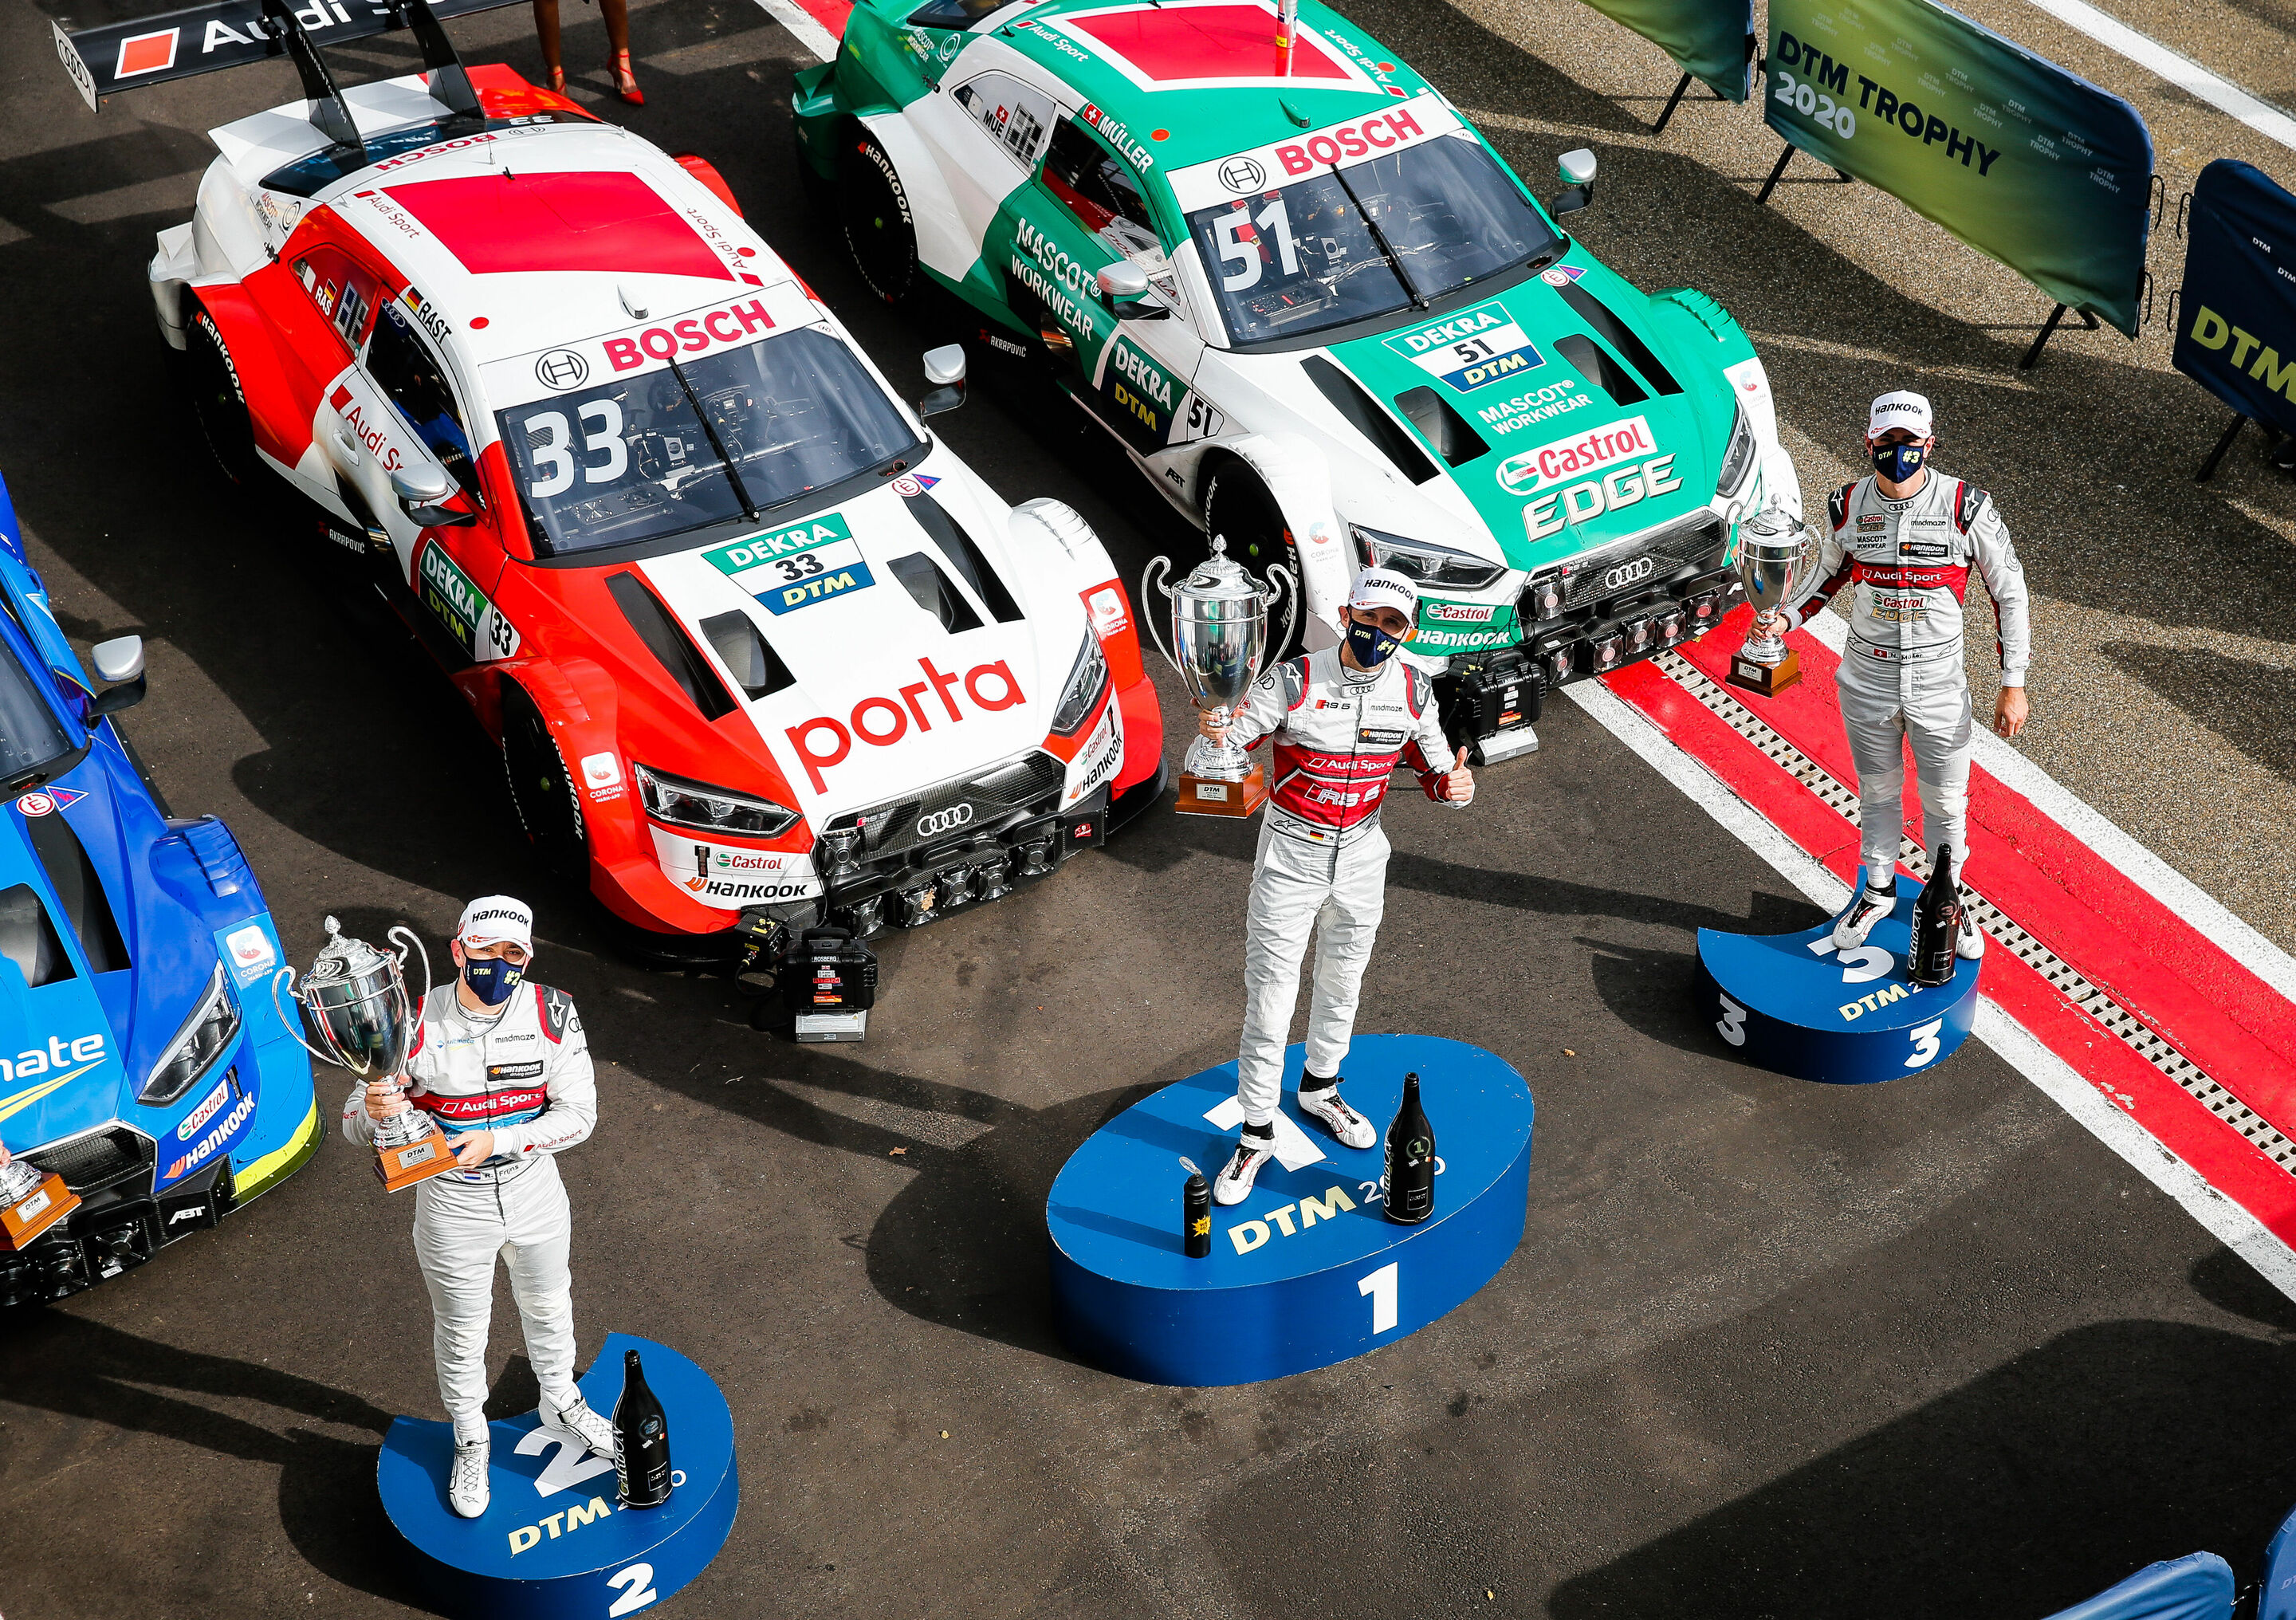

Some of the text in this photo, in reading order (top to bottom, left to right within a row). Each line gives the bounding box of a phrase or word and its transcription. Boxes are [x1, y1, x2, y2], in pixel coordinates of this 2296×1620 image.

[1028, 24, 1089, 63] Audi Sport
[1324, 29, 1392, 84] Audi Sport
[1917, 77, 1947, 97] TROPHY
[1924, 72, 1940, 85] DTM
[1945, 73, 1975, 93] TROPHY
[1952, 67, 1968, 81] DTM
[1774, 71, 1856, 140] 2020
[1777, 30, 2001, 178] DTM TROPHY
[1973, 108, 2003, 128] TROPHY
[1980, 103, 1996, 117] DTM
[2002, 104, 2032, 124] TROPHY
[2008, 99, 2026, 113] DTM
[983, 108, 1004, 139] MUE
[2068, 131, 2086, 144] DTM
[374, 134, 498, 171] BOSCH
[1099, 116, 1154, 174] MÜLLER
[1275, 109, 1424, 176] BOSCH
[2030, 140, 2060, 161] TROPHY
[2037, 134, 2054, 149] DTM
[2062, 135, 2094, 158] TROPHY
[2090, 171, 2121, 194] TROPHY
[2097, 167, 2115, 182] DTM
[367, 196, 421, 238] Audi Sport
[686, 207, 744, 269] Audi Sport
[1212, 199, 1299, 293] 51
[2252, 237, 2270, 253] DTM
[2278, 266, 2296, 283] DTM
[1012, 255, 1093, 340] WORKWEAR
[419, 301, 452, 344] RAST
[603, 299, 776, 372] BOSCH
[1404, 311, 1502, 352] DEKRA
[1453, 339, 1496, 363] 51
[2190, 305, 2296, 404] DTM
[1116, 342, 1171, 410] DEKRA
[1462, 352, 1529, 386] DTM
[1115, 382, 1157, 431] DTM
[1188, 398, 1213, 438] 51
[1491, 394, 1594, 435] WORKWEAR
[346, 406, 388, 457] Audi
[523, 399, 628, 498] 33
[1537, 423, 1649, 480] Castrol
[1878, 450, 1921, 463] DTM #3
[1165, 467, 1185, 488] ABT
[1522, 453, 1684, 543] EDGE
[1857, 523, 1885, 533] EDGE
[1864, 514, 1883, 523] Castrol
[726, 523, 838, 568] DEKRA
[776, 553, 824, 581] 33
[1874, 571, 1941, 583] Audi Sport
[426, 547, 477, 623] DEKRA
[782, 571, 856, 607] DTM
[429, 588, 467, 644] DTM
[1443, 606, 1490, 619] Castrol
[1870, 608, 1928, 623] EDGE
[1883, 597, 1924, 609] Castrol
[490, 611, 513, 656] 33
[1355, 630, 1395, 655] DTM #1
[784, 657, 1027, 796] porta
[1087, 722, 1107, 758] Castrol
[1327, 759, 1358, 770] Audi
[589, 785, 623, 799] CORONA
[732, 855, 782, 871] Castrol
[241, 958, 276, 977] CORONA
[503, 970, 521, 985] #2
[1838, 983, 1909, 1022] DTM
[1716, 993, 1746, 1046] 3
[495, 1034, 536, 1044] mindmaze
[1904, 1018, 1942, 1068] 3
[191, 1083, 227, 1131] Castrol
[461, 1093, 542, 1112] Audi Sport
[407, 1147, 425, 1158] DTM
[536, 1129, 583, 1150] Audi Sport
[1414, 1141, 1425, 1154] 1
[25, 1197, 41, 1210] DTM
[168, 1205, 206, 1225] ABT
[1227, 1186, 1357, 1256] DTM
[1357, 1261, 1398, 1335] 1
[508, 1496, 611, 1555] DTM
[606, 1562, 656, 1618] 2
